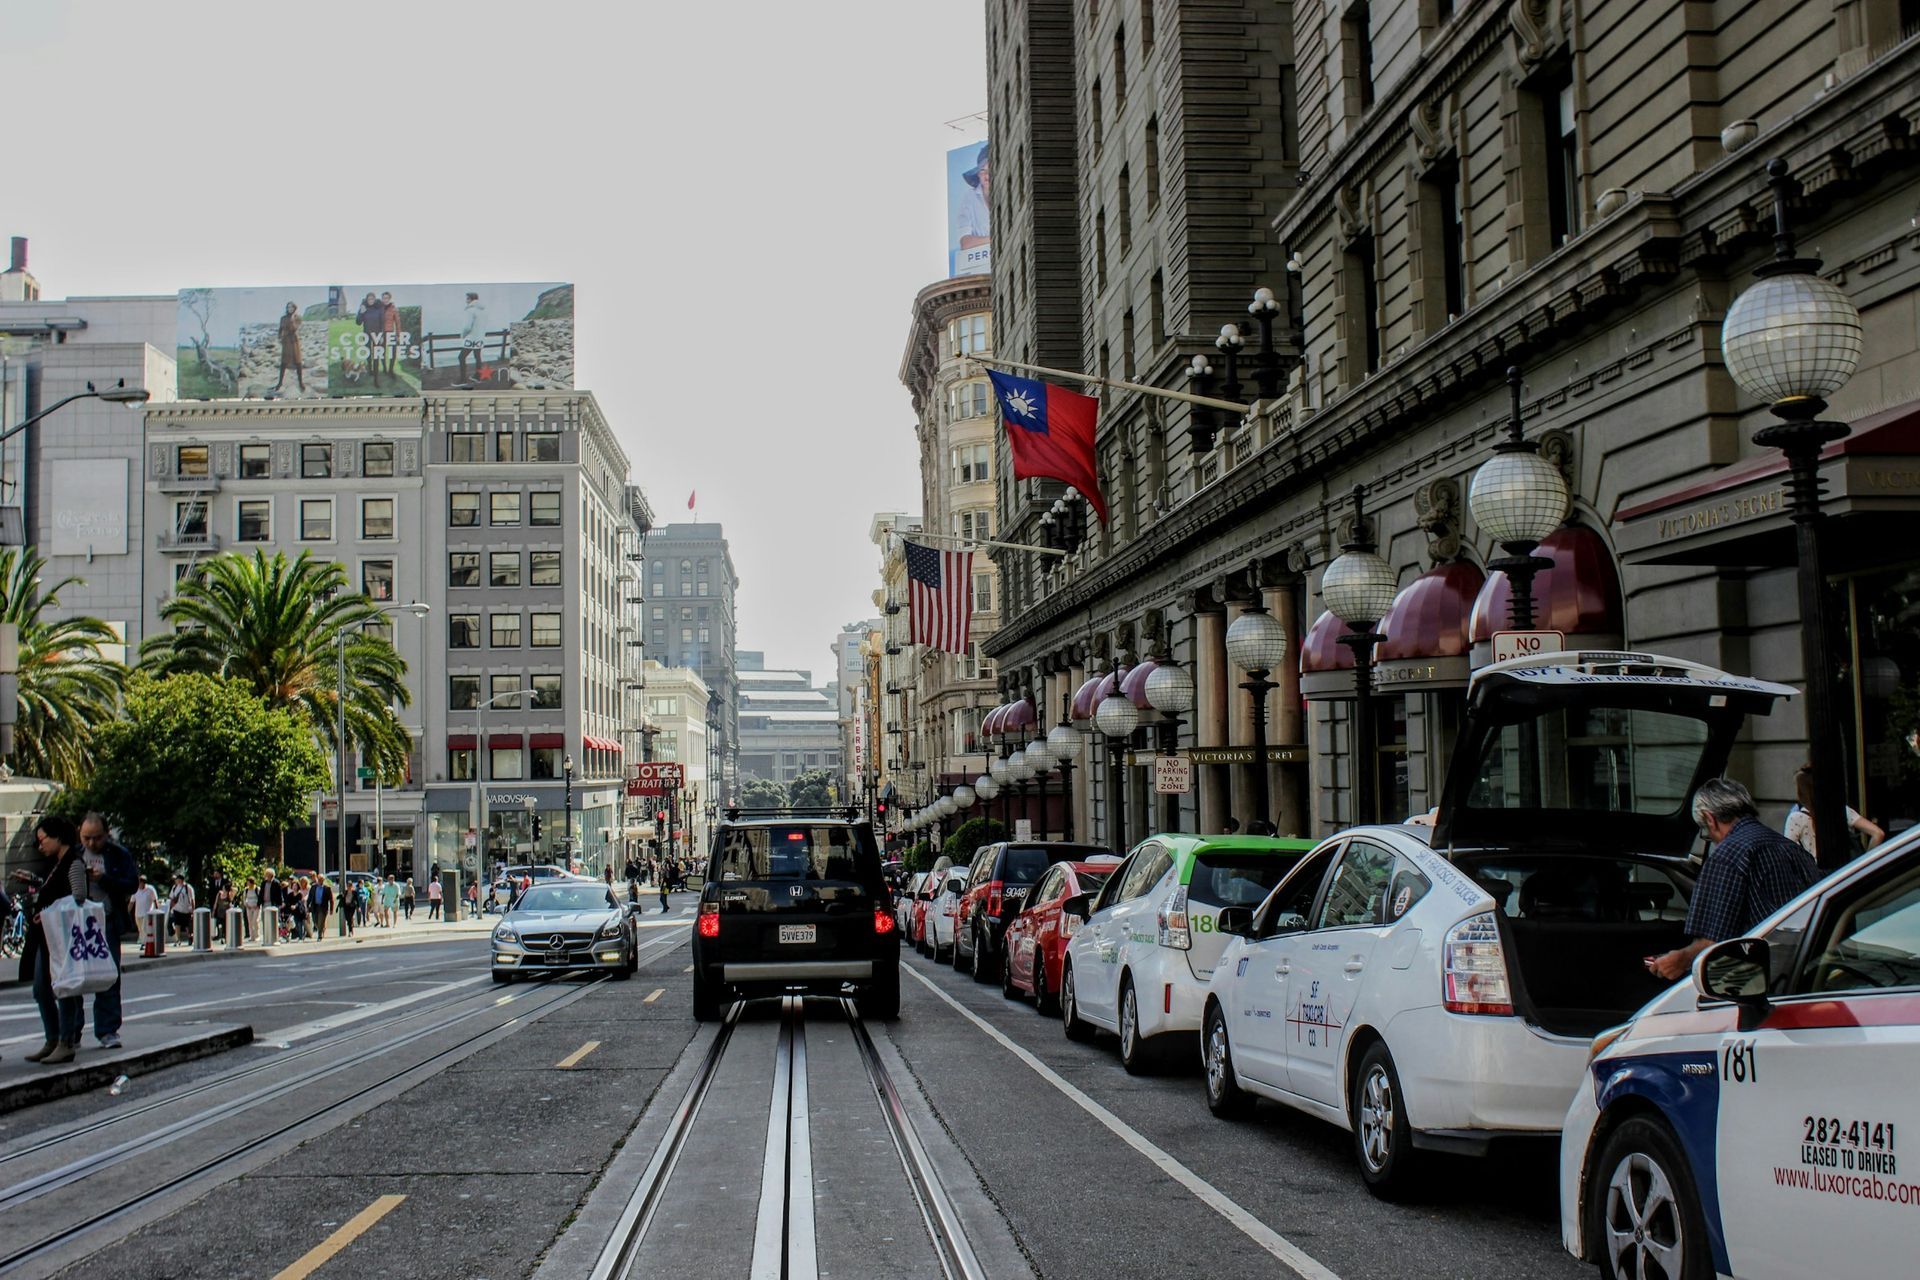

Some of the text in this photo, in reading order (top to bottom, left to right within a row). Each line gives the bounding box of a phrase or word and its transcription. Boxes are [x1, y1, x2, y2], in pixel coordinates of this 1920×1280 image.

[968, 250, 991, 262] PER
[340, 332, 411, 346] COVER
[331, 345, 421, 360] STORIES
[1657, 489, 1786, 539] VICTORIA'S SECRET
[1516, 637, 1541, 651] NO
[1606, 675, 1692, 685] FRANCISCO
[1267, 751, 1293, 760] CRET
[1166, 759, 1179, 768] NO
[1157, 767, 1188, 775] PARKING
[1005, 887, 1027, 898] 9048
[781, 931, 814, 941] 5VVE379
[1721, 1038, 1757, 1083] 781
[1803, 1116, 1895, 1152] 282-4141
[1801, 1144, 1896, 1175] LEASED TO DRIVER
[1773, 1166, 1920, 1206] www.luxorcab.com
